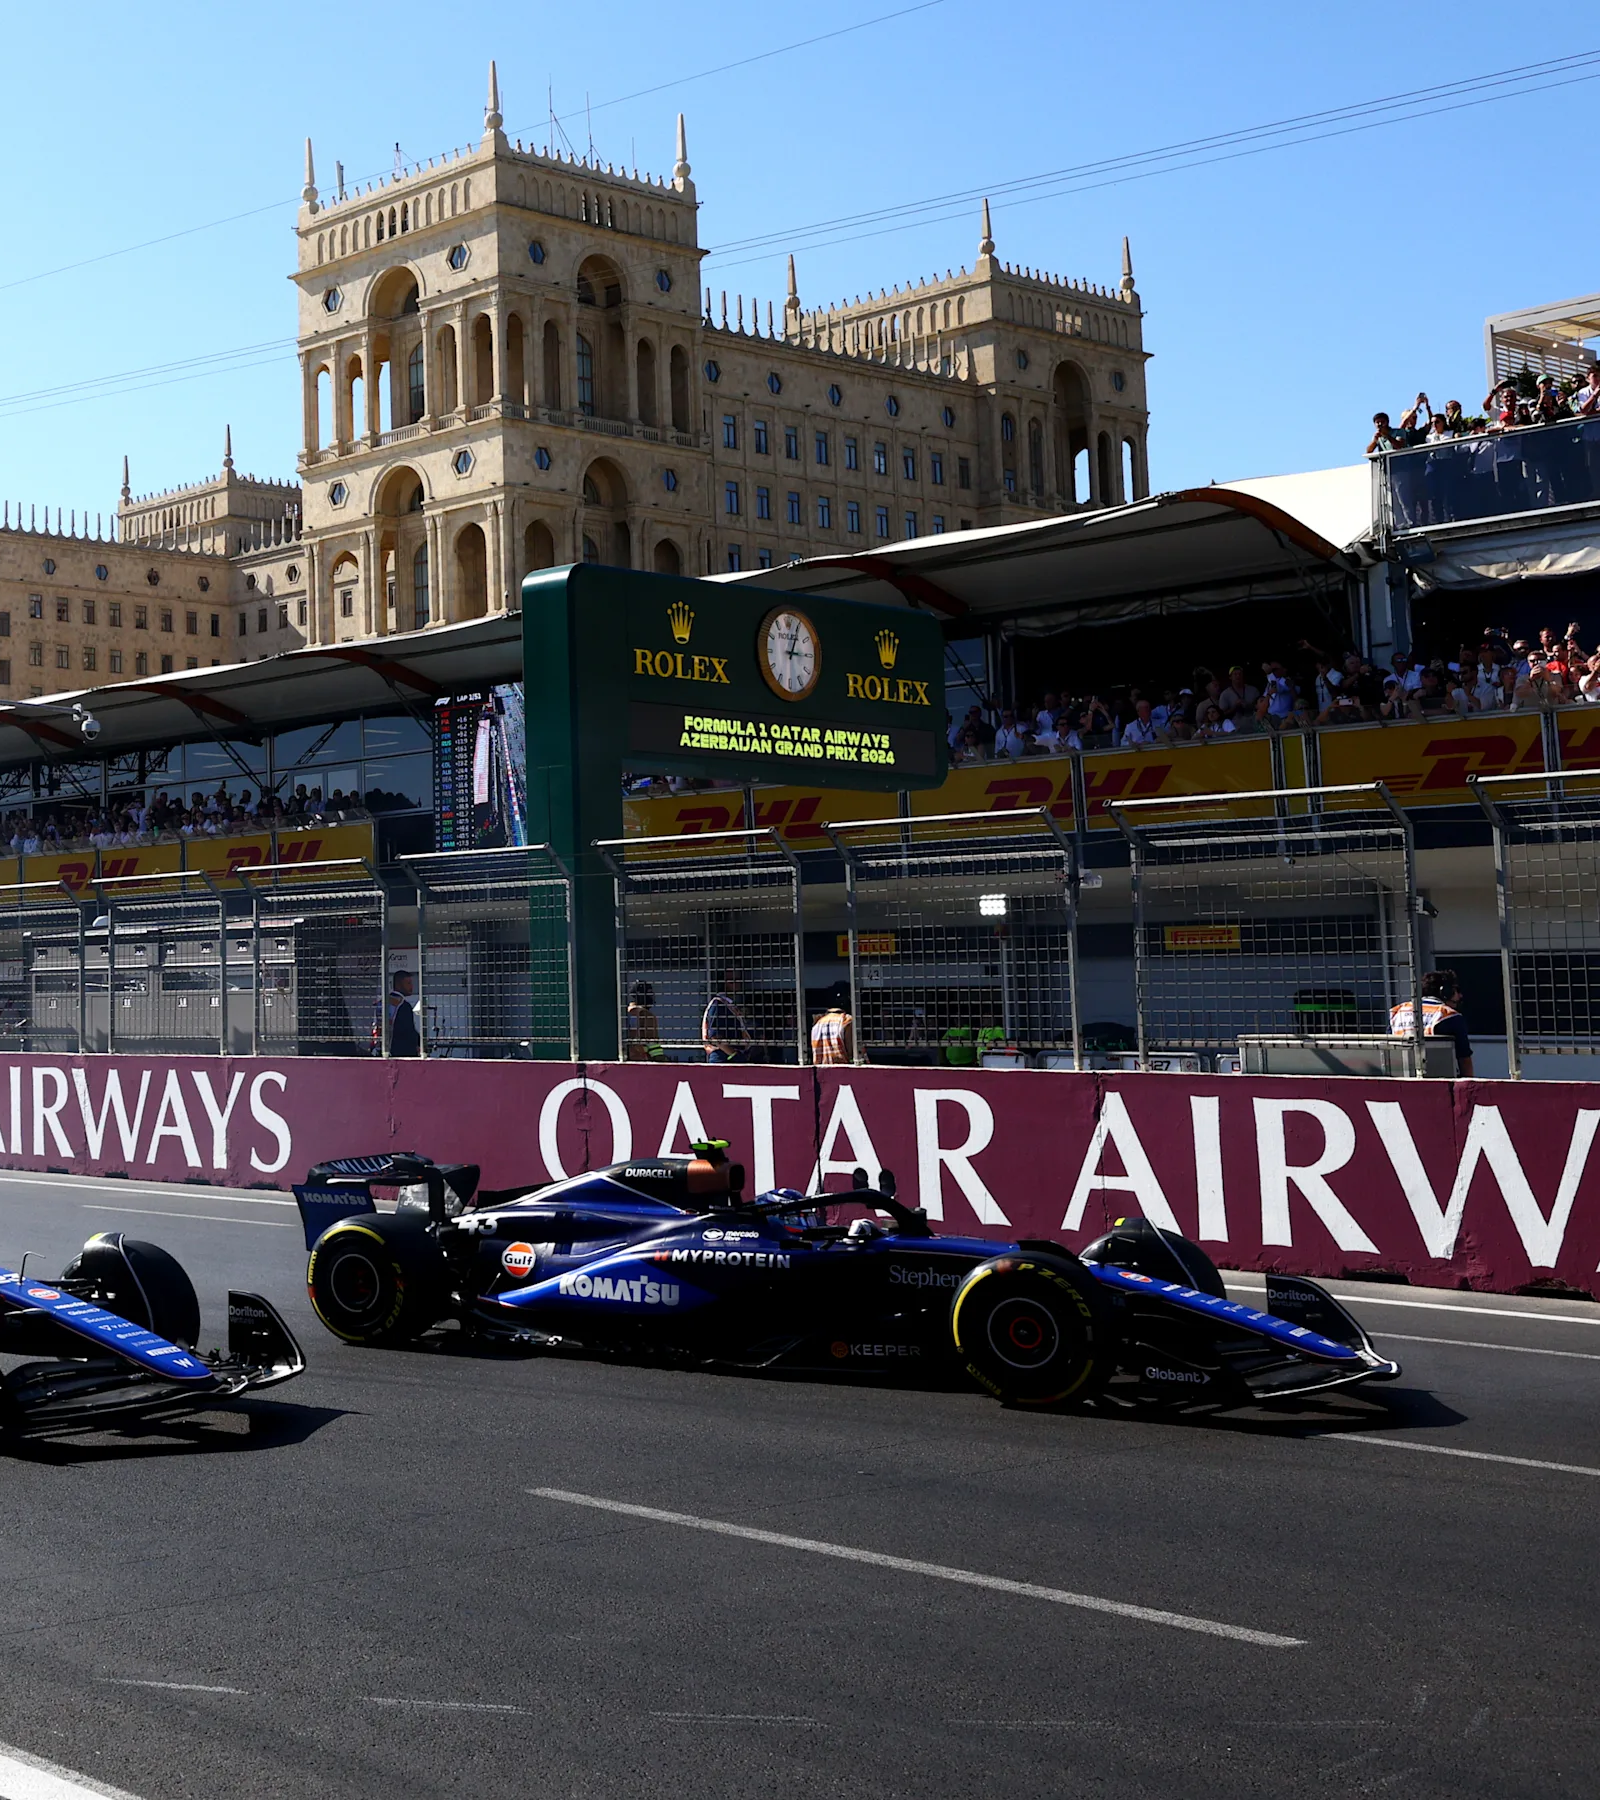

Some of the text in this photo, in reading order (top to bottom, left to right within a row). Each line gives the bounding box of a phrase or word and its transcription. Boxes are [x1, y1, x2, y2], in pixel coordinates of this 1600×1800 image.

[634, 648, 731, 684] ROLEX
[457, 694, 468, 702] LAP
[846, 673, 931, 706] ROLEX
[684, 715, 890, 749] FORMULA 1 QATAR AIRWAYS
[680, 731, 896, 765] AZERBAIJAN GRAND PRIX 2024
[983, 765, 1180, 824] DHL
[667, 797, 828, 848] DHL
[226, 840, 323, 879] DHL
[56, 858, 140, 893] DHL
[842, 938, 890, 952] PRELLI
[1171, 929, 1233, 946] PIRELLI
[331, 1155, 393, 1174] WILLIA
[538, 1078, 1600, 1271] QATAR AIRW
[624, 1168, 674, 1180] DURACELL
[302, 1191, 367, 1205] KOMATSU
[455, 1213, 498, 1236] 43
[724, 1230, 759, 1239] mercado
[504, 1252, 533, 1267] Gulf
[671, 1249, 791, 1269] MYPROTEIN
[888, 1264, 966, 1290] Stephen
[558, 1274, 680, 1307] KOMATSU
[1017, 1262, 1036, 1271] P
[1037, 1268, 1093, 1318] ZERO
[850, 1344, 921, 1357] KEEPER
[1145, 1366, 1201, 1383] Globant
